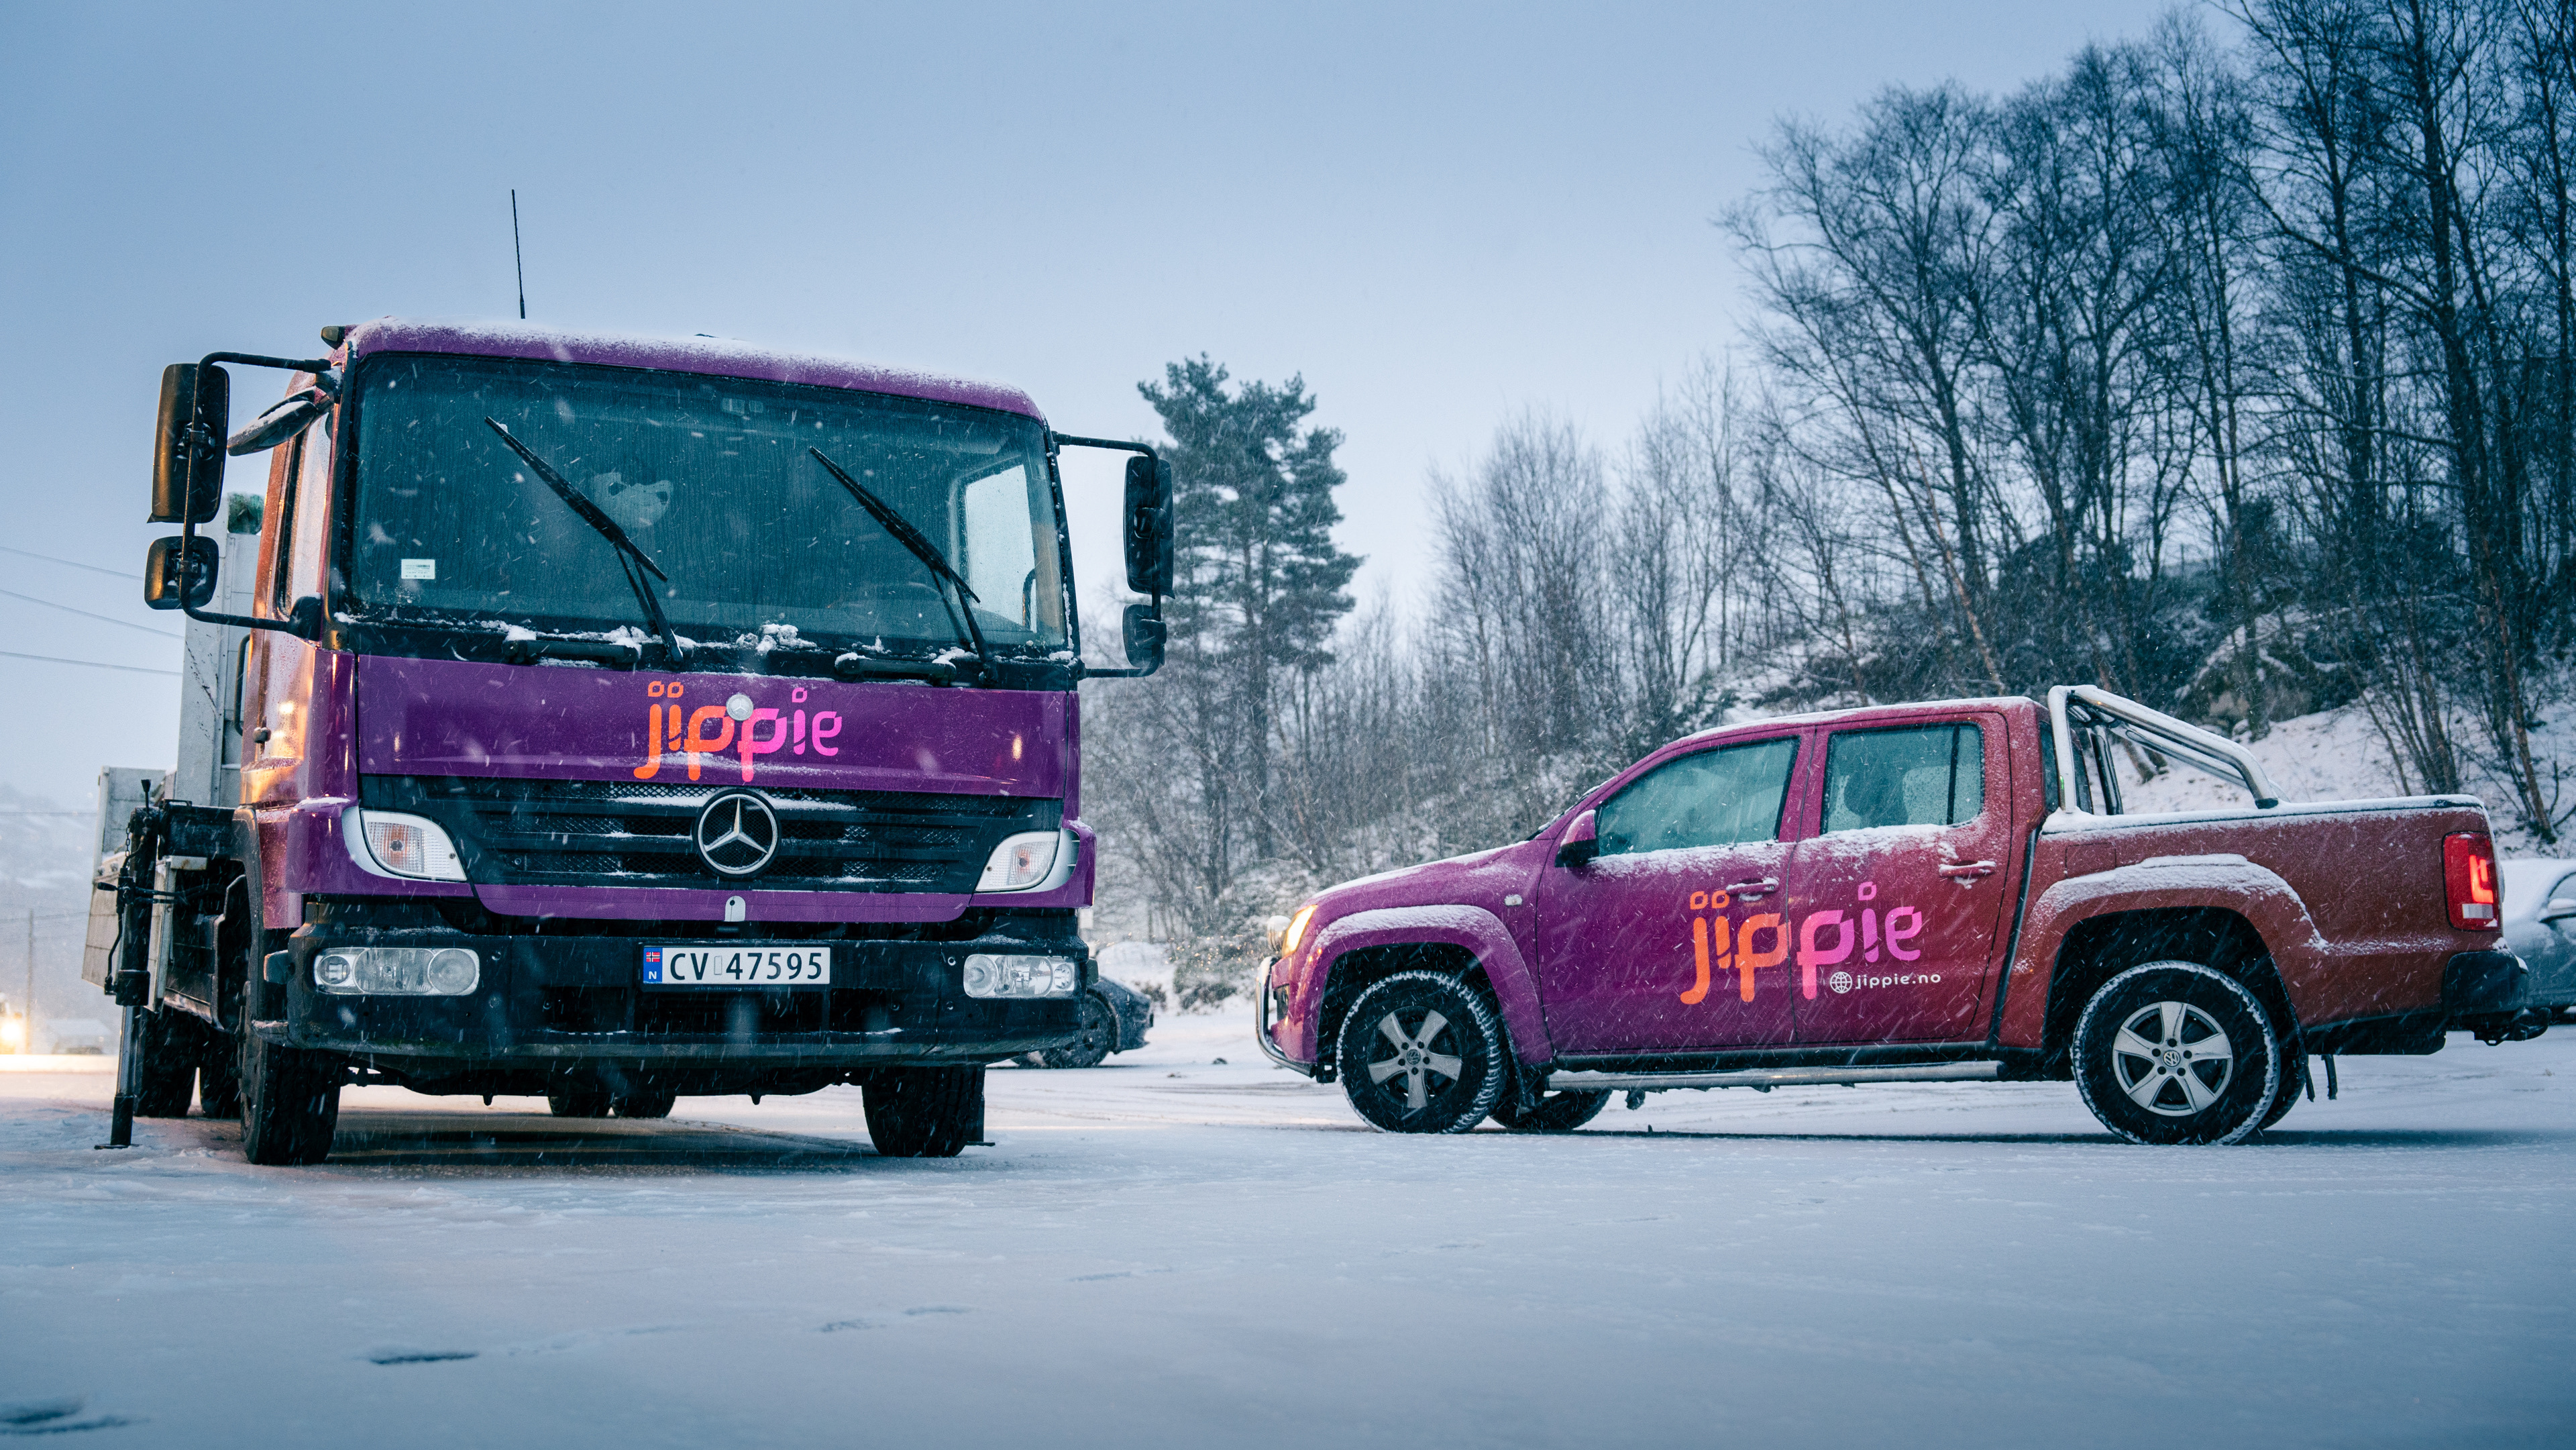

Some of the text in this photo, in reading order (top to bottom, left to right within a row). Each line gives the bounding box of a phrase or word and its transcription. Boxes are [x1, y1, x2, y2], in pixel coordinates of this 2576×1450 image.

[633, 680, 843, 782] jippie
[1680, 881, 1923, 1005] jippie
[649, 971, 657, 980] N
[670, 953, 822, 980] CV 47595
[1855, 974, 1941, 990] jippie.no
